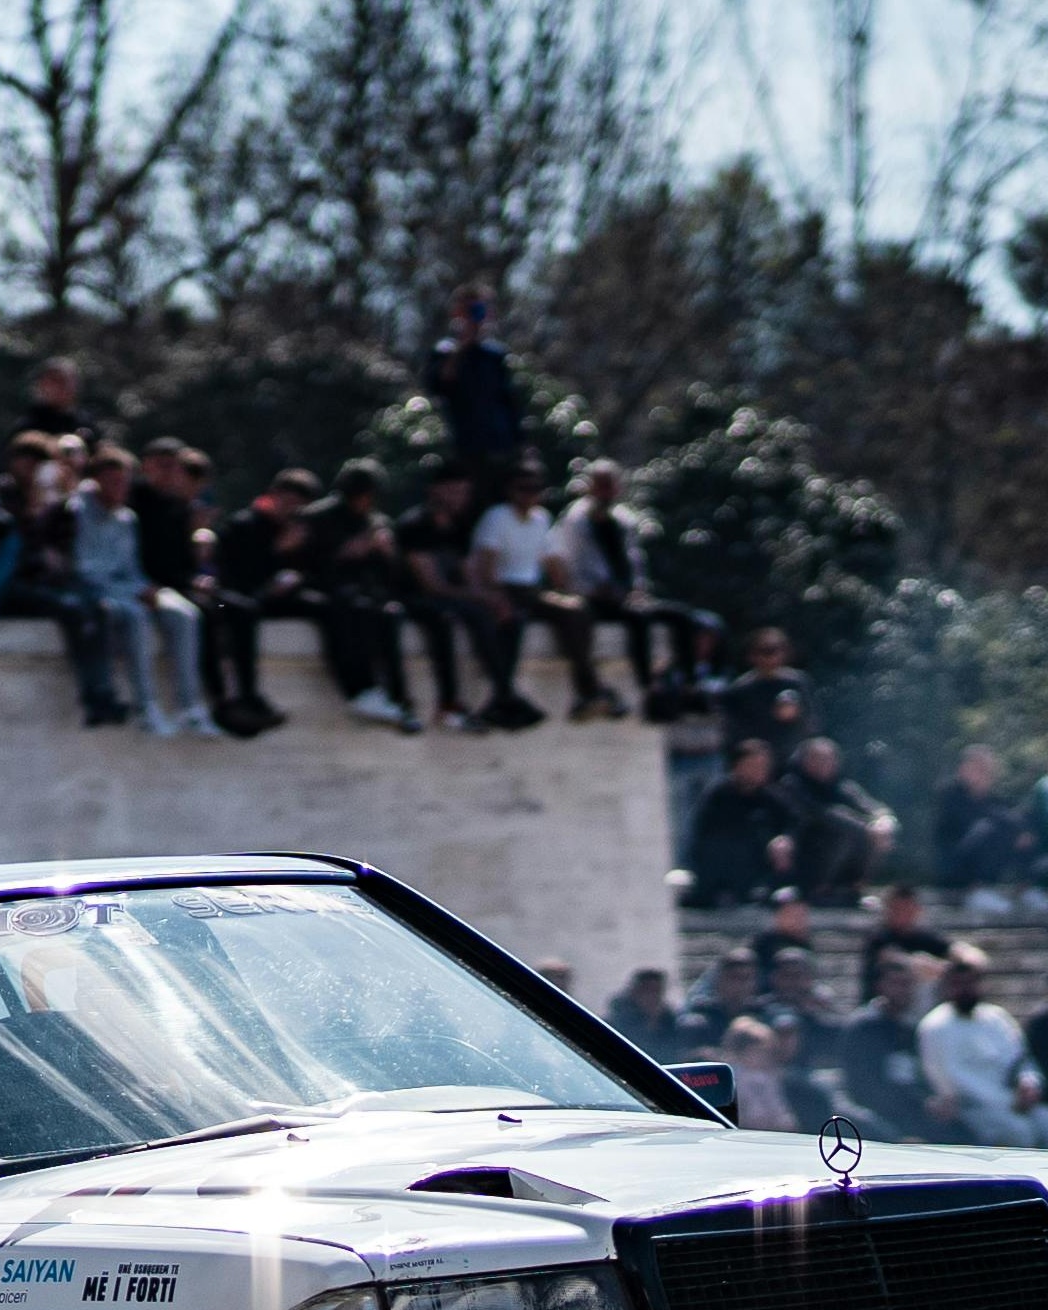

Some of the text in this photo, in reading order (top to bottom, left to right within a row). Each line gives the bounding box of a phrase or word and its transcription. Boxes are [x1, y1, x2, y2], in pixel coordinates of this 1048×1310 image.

[0, 1259, 76, 1283] SAIYAN
[82, 1271, 177, 1303] MË I FORTI
